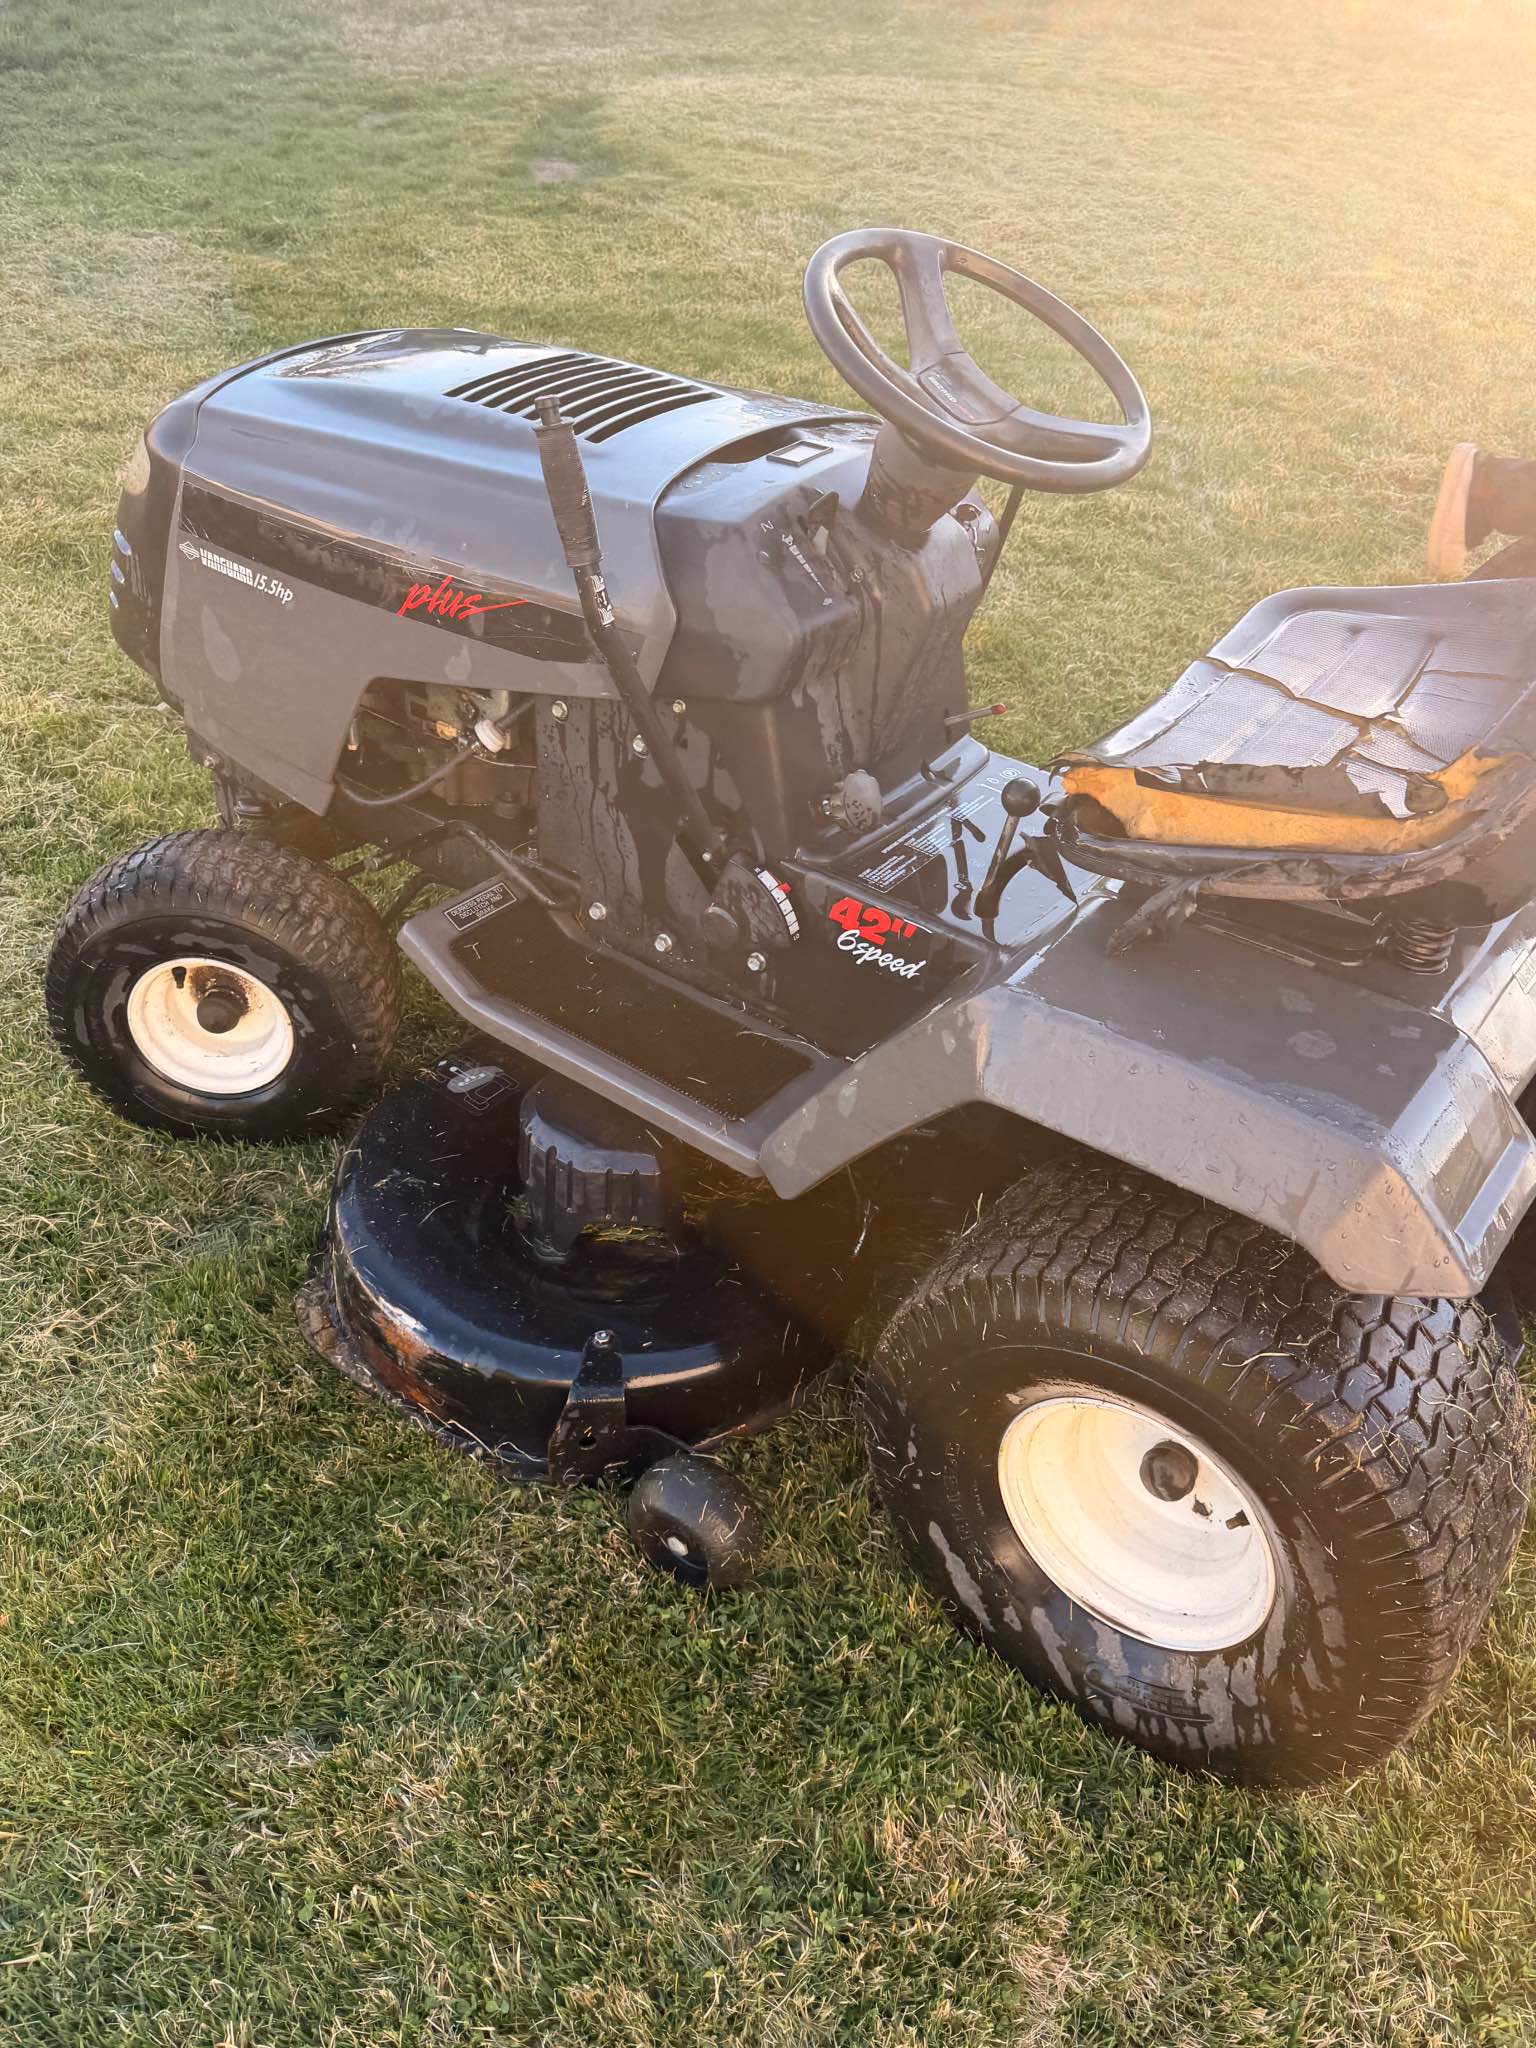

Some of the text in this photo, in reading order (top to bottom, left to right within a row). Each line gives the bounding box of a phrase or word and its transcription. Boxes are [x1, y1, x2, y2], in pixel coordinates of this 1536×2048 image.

[200, 548, 294, 604] VANGUARD 15.5hp
[396, 574, 529, 620] plus
[476, 892, 494, 903] PEDAL
